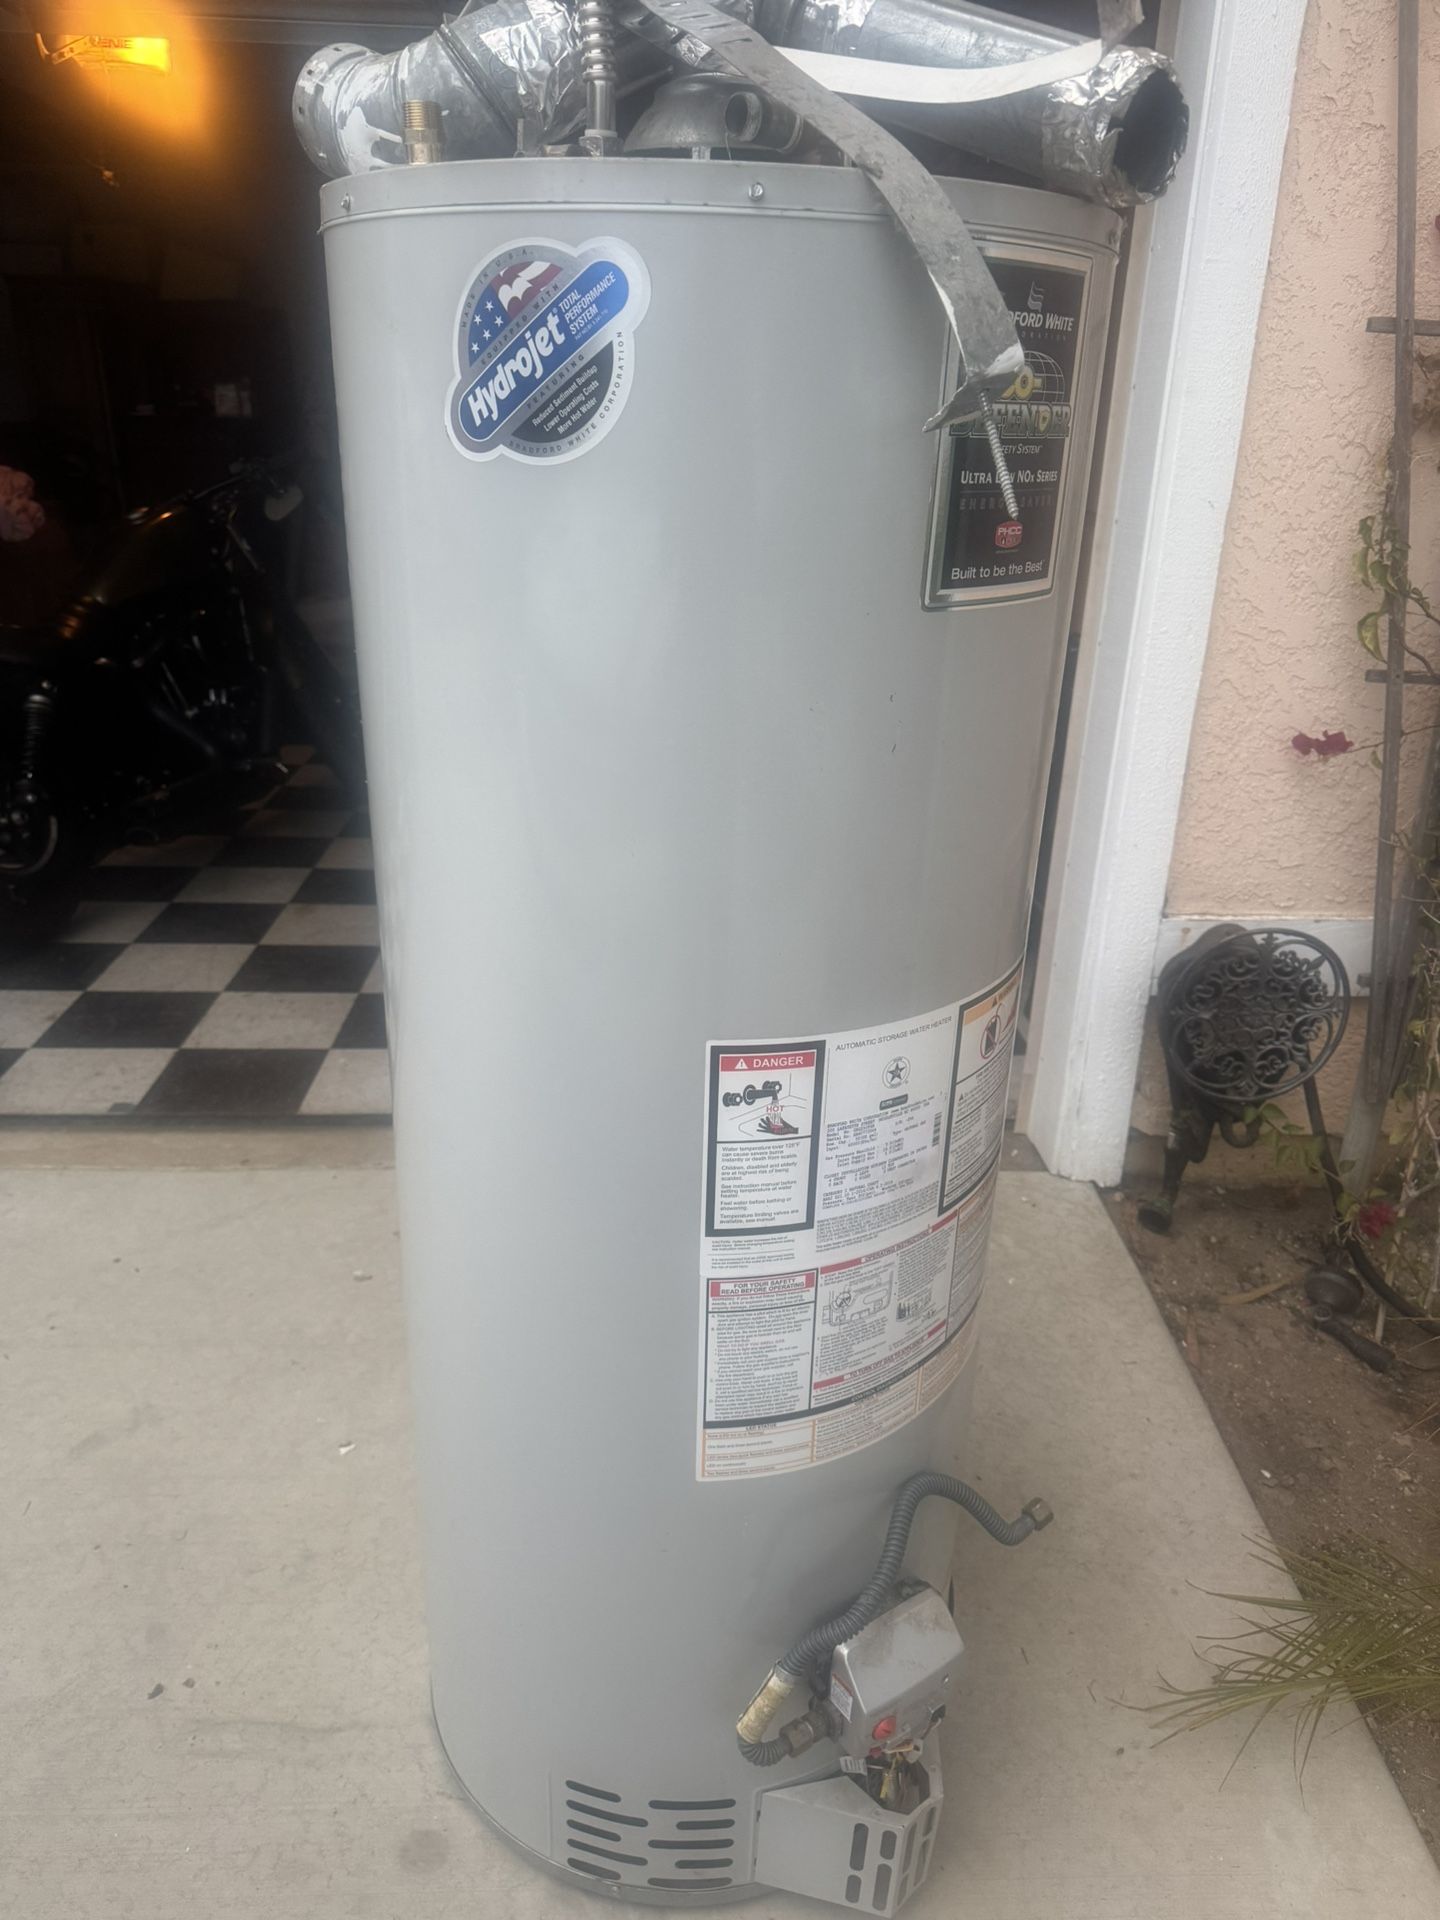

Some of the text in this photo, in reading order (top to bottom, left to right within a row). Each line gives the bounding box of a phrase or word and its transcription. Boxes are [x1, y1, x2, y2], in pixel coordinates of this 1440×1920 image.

[559, 289, 581, 313] TOTAL
[564, 271, 616, 324] PERFORMANCE
[569, 303, 598, 335] SYSTEM
[1045, 313, 1074, 331] WHITE
[526, 352, 584, 409] FEATURING
[568, 422, 597, 447] WHITE
[599, 331, 625, 419] CORPORATION
[532, 365, 598, 426] Reduced Sediment Buildup
[543, 380, 599, 432] Lower Operating Costs
[557, 397, 597, 434] More Hot Water
[1001, 445, 1017, 454] FETY
[998, 526, 1022, 536] PHCC
[951, 561, 1043, 580] Built to be the Best
[836, 1015, 952, 1051] AUTOMATIC STORAGE WATER HEATER
[753, 1056, 804, 1068] DANGER
[766, 1105, 785, 1113] HOT
[740, 1144, 771, 1152] temperature
[768, 1281, 804, 1291] OPERATING
[770, 1278, 796, 1286] SAFETY
